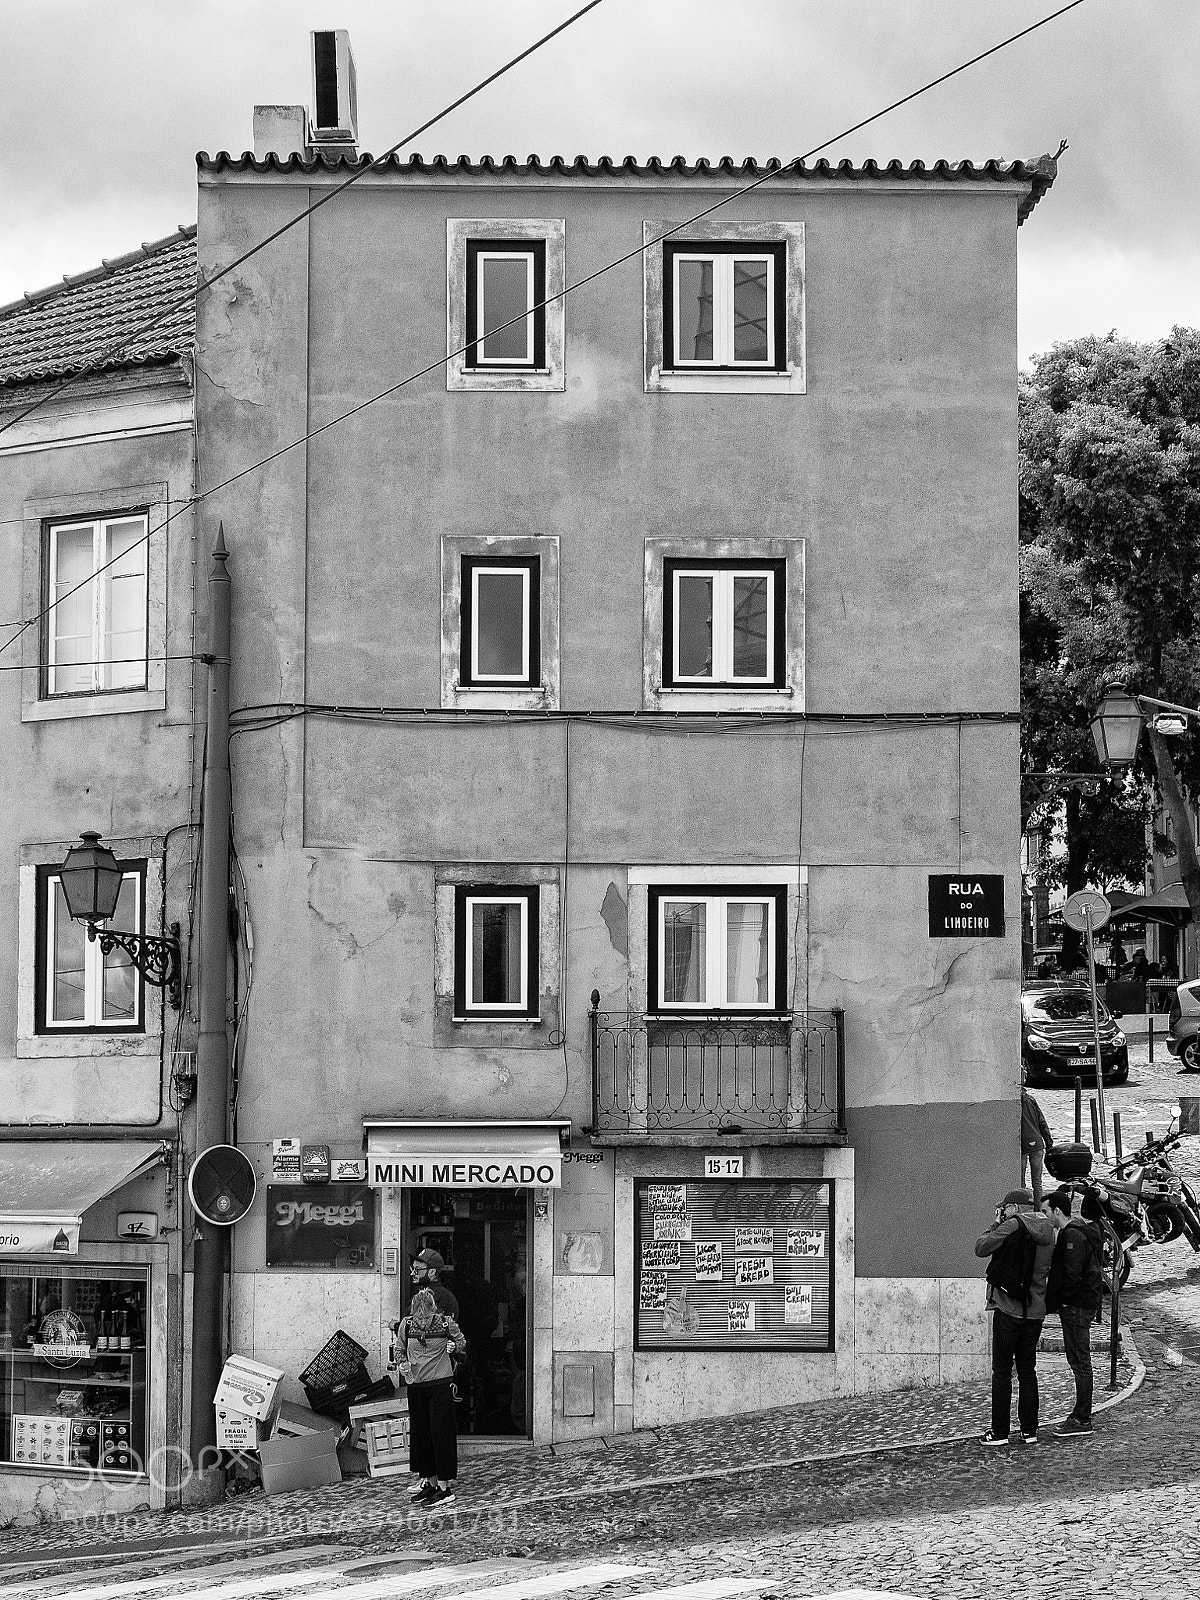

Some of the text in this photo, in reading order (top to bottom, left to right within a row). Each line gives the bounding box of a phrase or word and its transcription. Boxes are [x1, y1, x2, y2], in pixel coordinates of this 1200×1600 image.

[948, 883, 985, 895] RUA
[960, 902, 973, 910] DO
[944, 916, 989, 929] LIMOEIRO
[563, 1151, 604, 1164] Meggi
[707, 1159, 740, 1174] 15-17
[375, 1164, 554, 1184] MINI MERCADO
[276, 1200, 365, 1226] Meggi
[736, 1259, 766, 1276] FRESH
[740, 1269, 770, 1283] BREAD
[42, 1345, 64, 1356] Santa
[65, 1346, 87, 1357] Luzia
